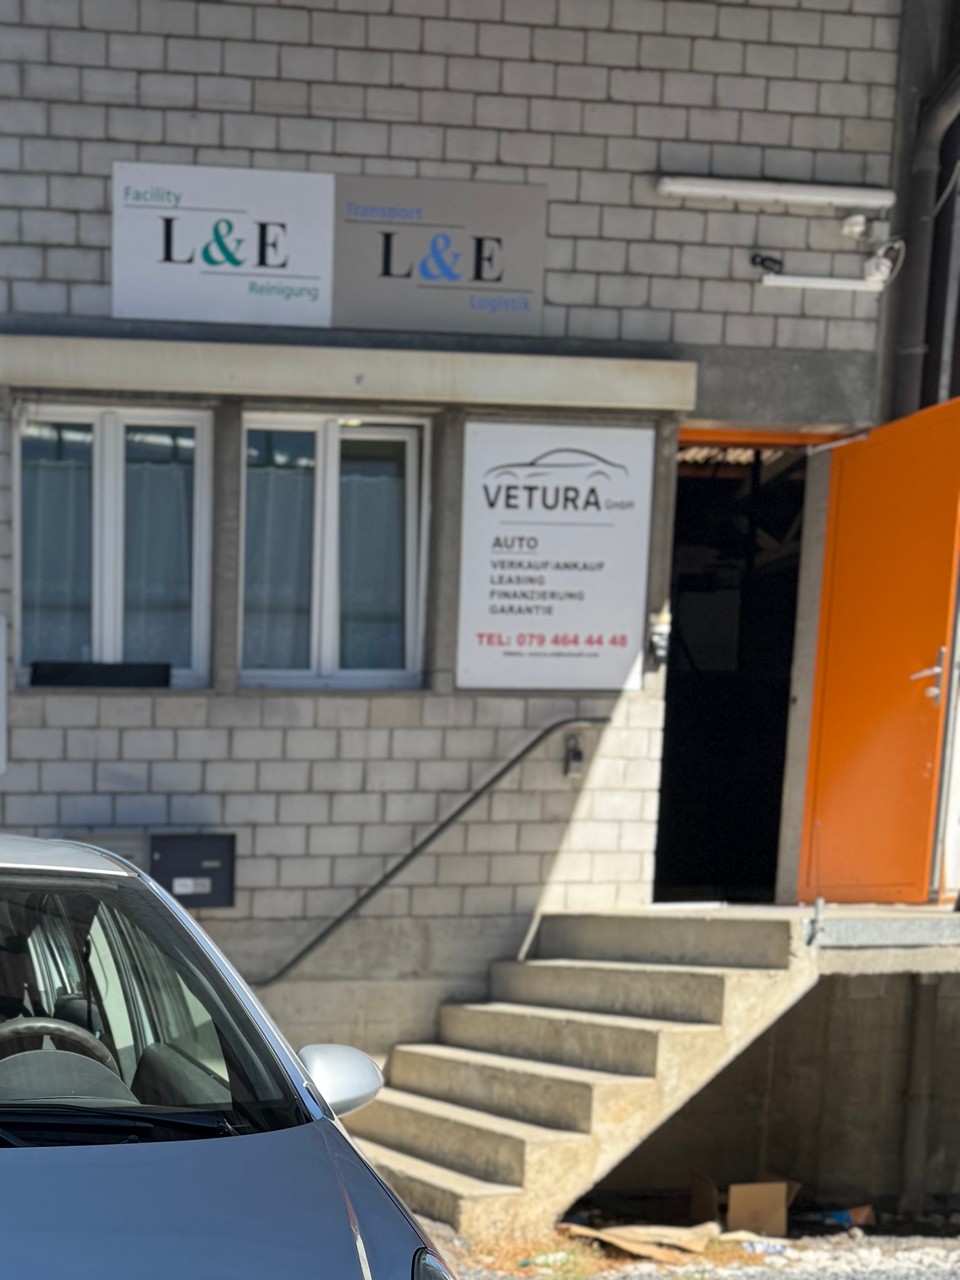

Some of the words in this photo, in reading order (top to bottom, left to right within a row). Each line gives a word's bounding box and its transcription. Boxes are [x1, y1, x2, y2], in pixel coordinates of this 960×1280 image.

[123, 186, 183, 207] Facility
[346, 202, 423, 221] Transport
[248, 281, 319, 301] Reinigung
[469, 294, 531, 313] Logistik
[483, 484, 602, 511] VETURA
[492, 536, 539, 550] AUTO
[490, 575, 546, 586] LEASING
[489, 590, 585, 602] FINANZIERUNG
[489, 605, 553, 616] GARANTIE
[476, 633, 511, 647] TEL:
[516, 633, 546, 647] 079
[584, 634, 604, 647] 44
